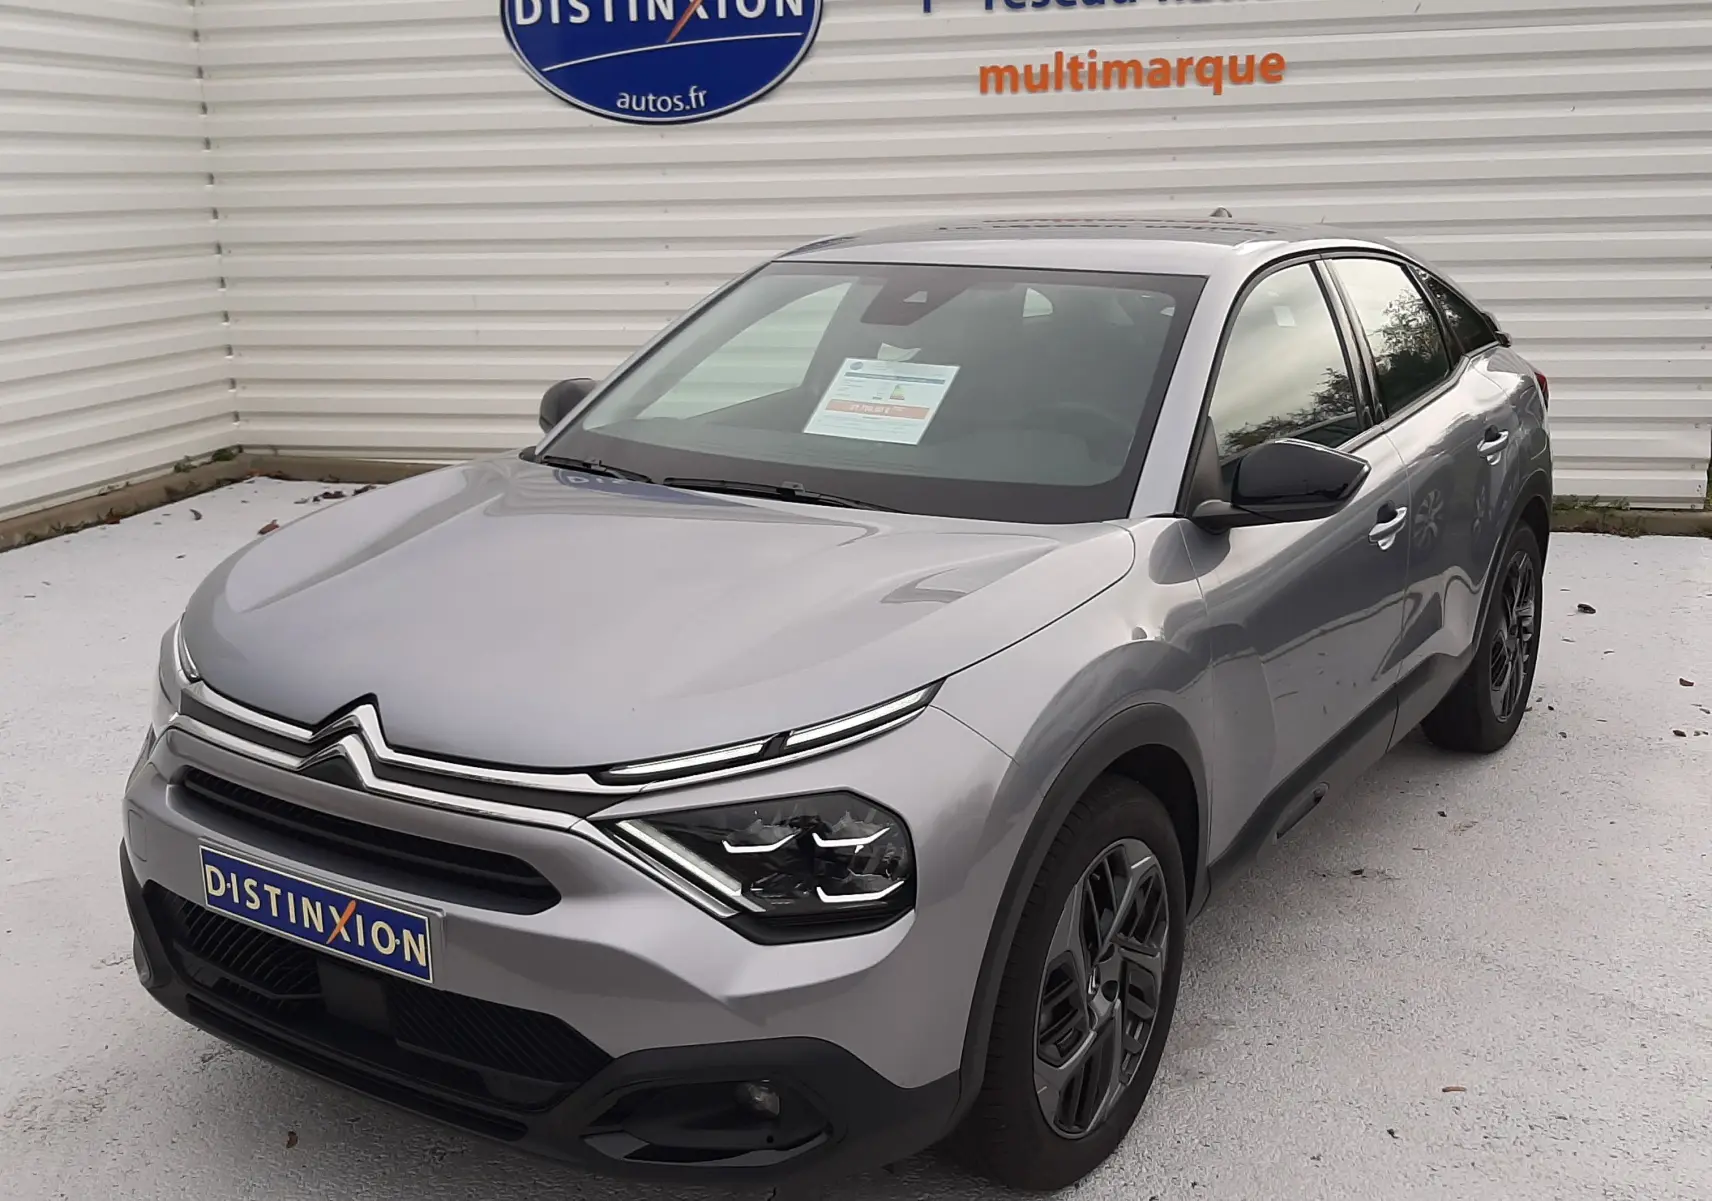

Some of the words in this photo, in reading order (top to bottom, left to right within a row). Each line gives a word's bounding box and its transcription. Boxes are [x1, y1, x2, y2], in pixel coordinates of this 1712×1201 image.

[980, 49, 1286, 96] multimarque
[616, 86, 708, 112] autos.fr
[205, 864, 427, 966] DISTINXION
